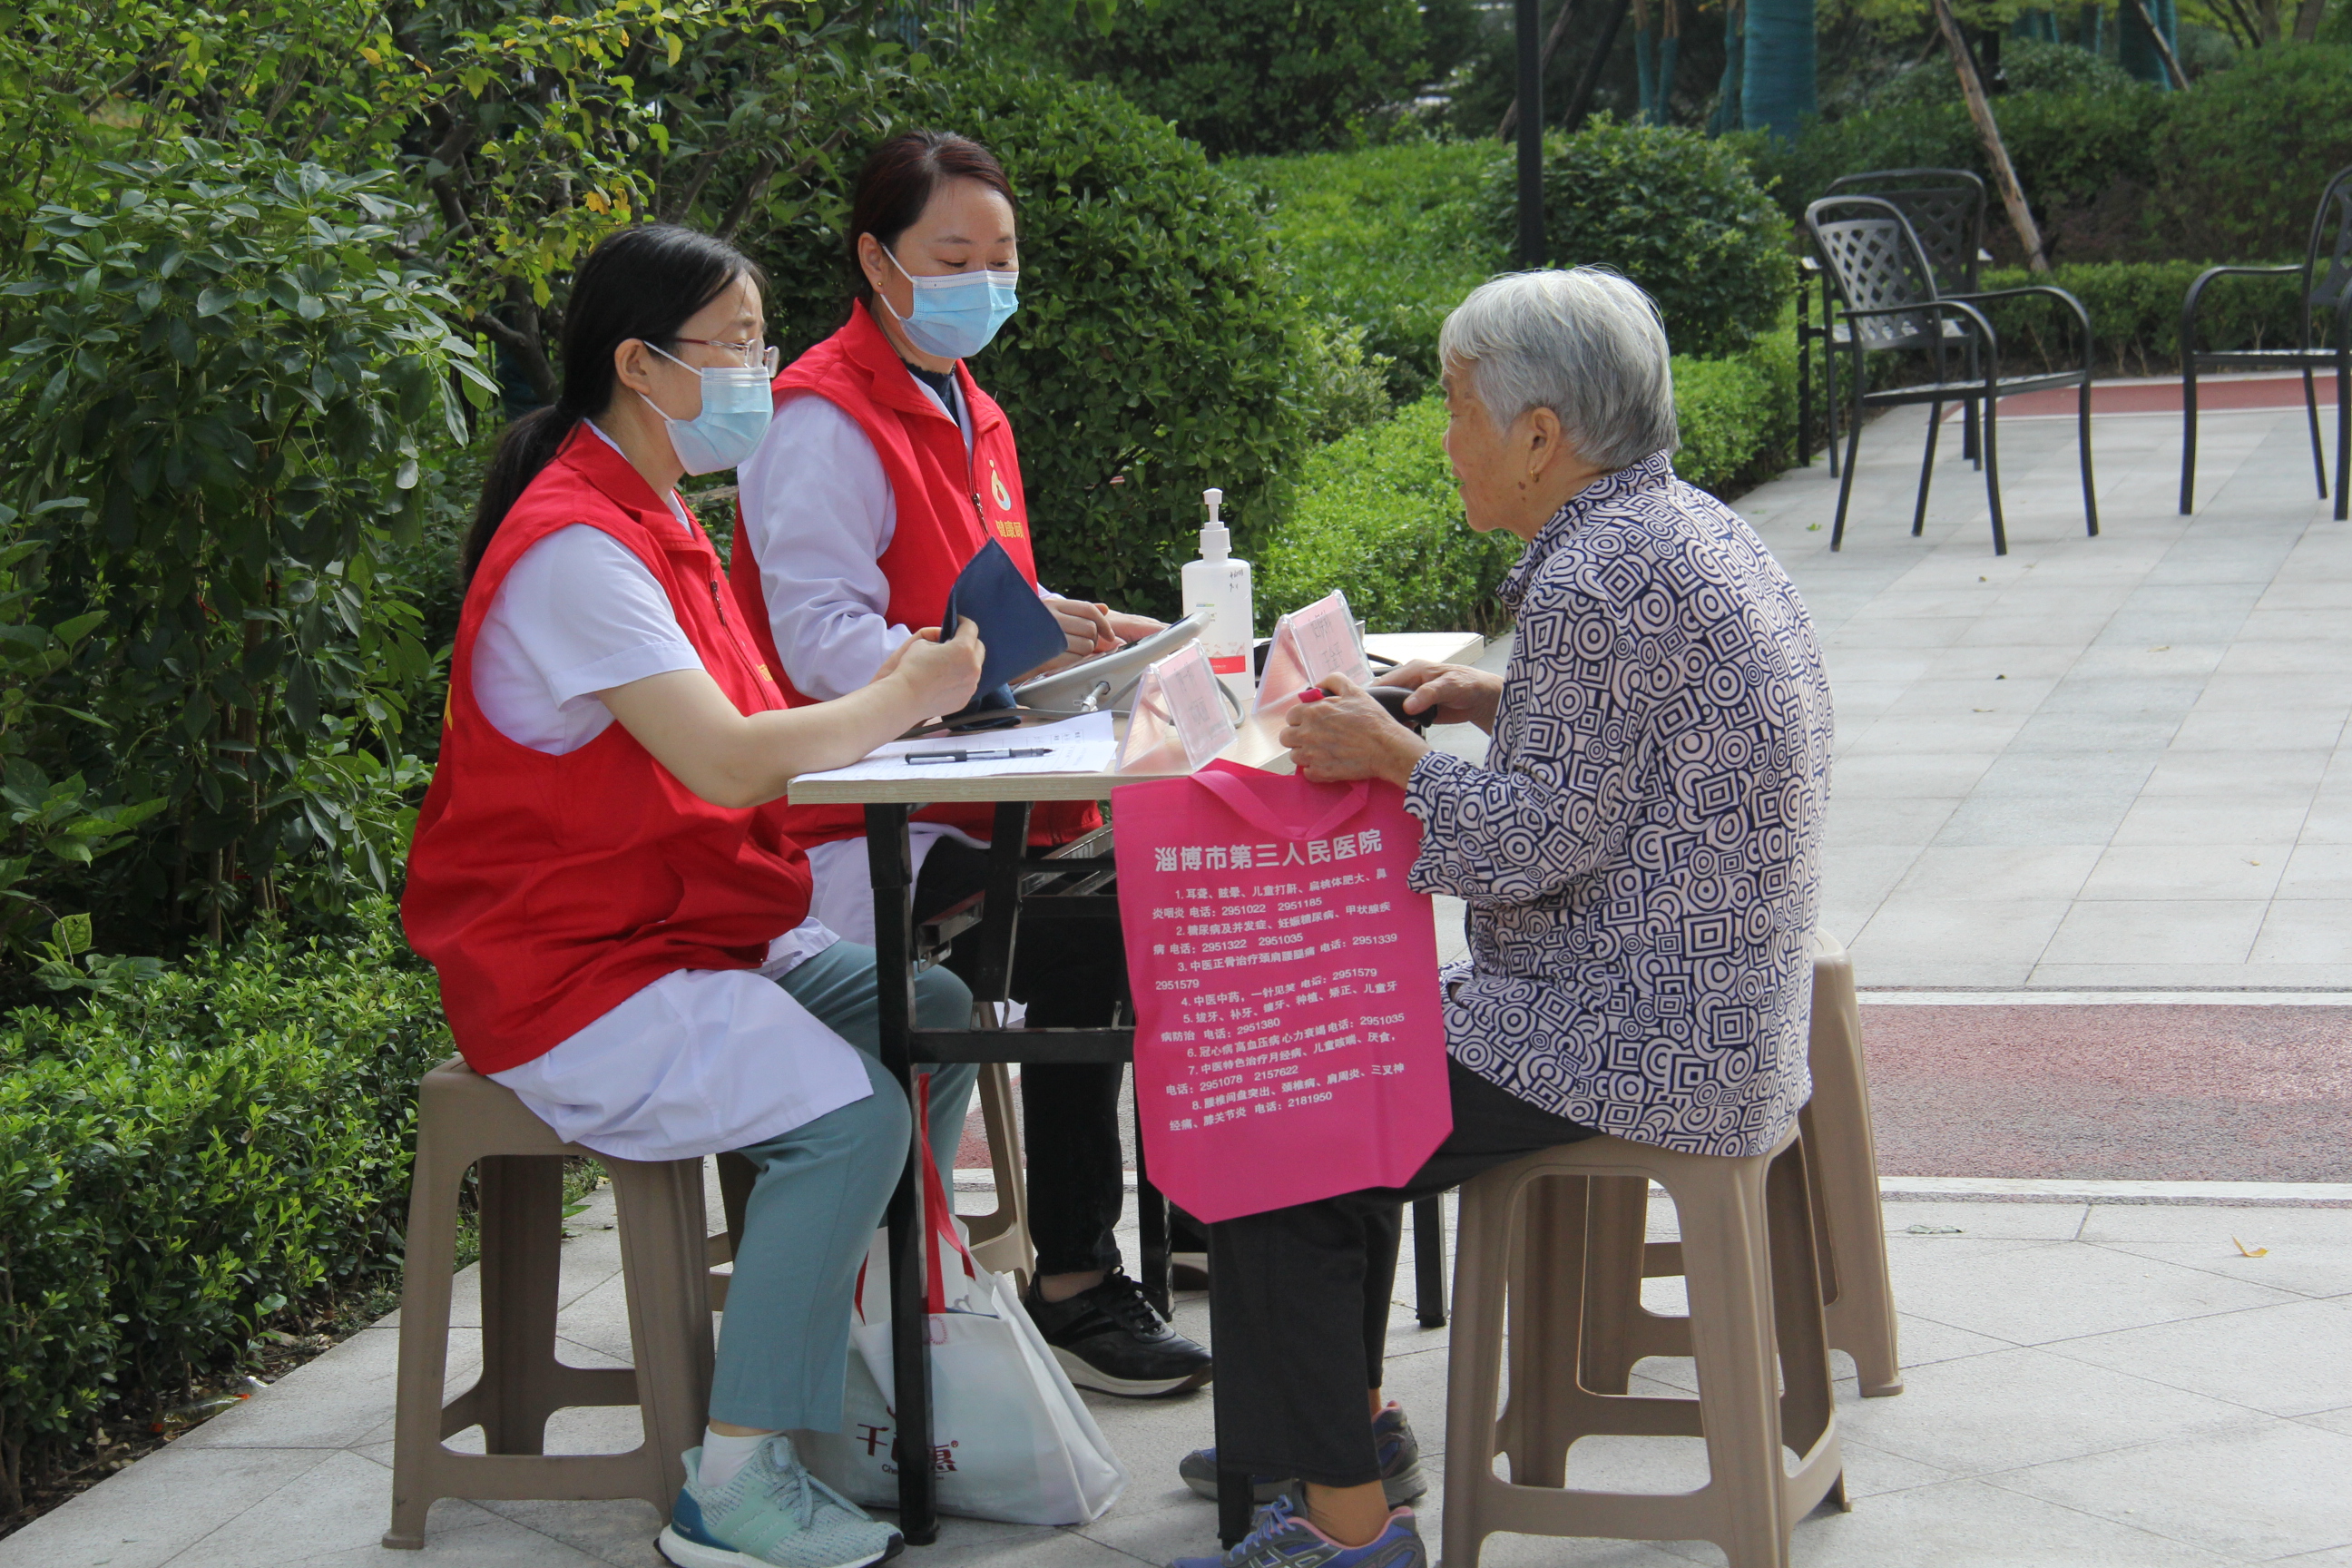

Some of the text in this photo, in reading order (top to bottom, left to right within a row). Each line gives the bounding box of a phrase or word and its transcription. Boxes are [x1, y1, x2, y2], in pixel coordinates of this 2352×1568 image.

[1154, 828, 1382, 872] 淄博市第三人民医院
[1278, 897, 1322, 911] 2951185
[1153, 944, 1165, 955] 病
[1259, 932, 1304, 946] 2951035
[1155, 979, 1200, 990] 2951579
[1161, 1030, 1195, 1042] 病防治
[1254, 1065, 1298, 1082] 2157622
